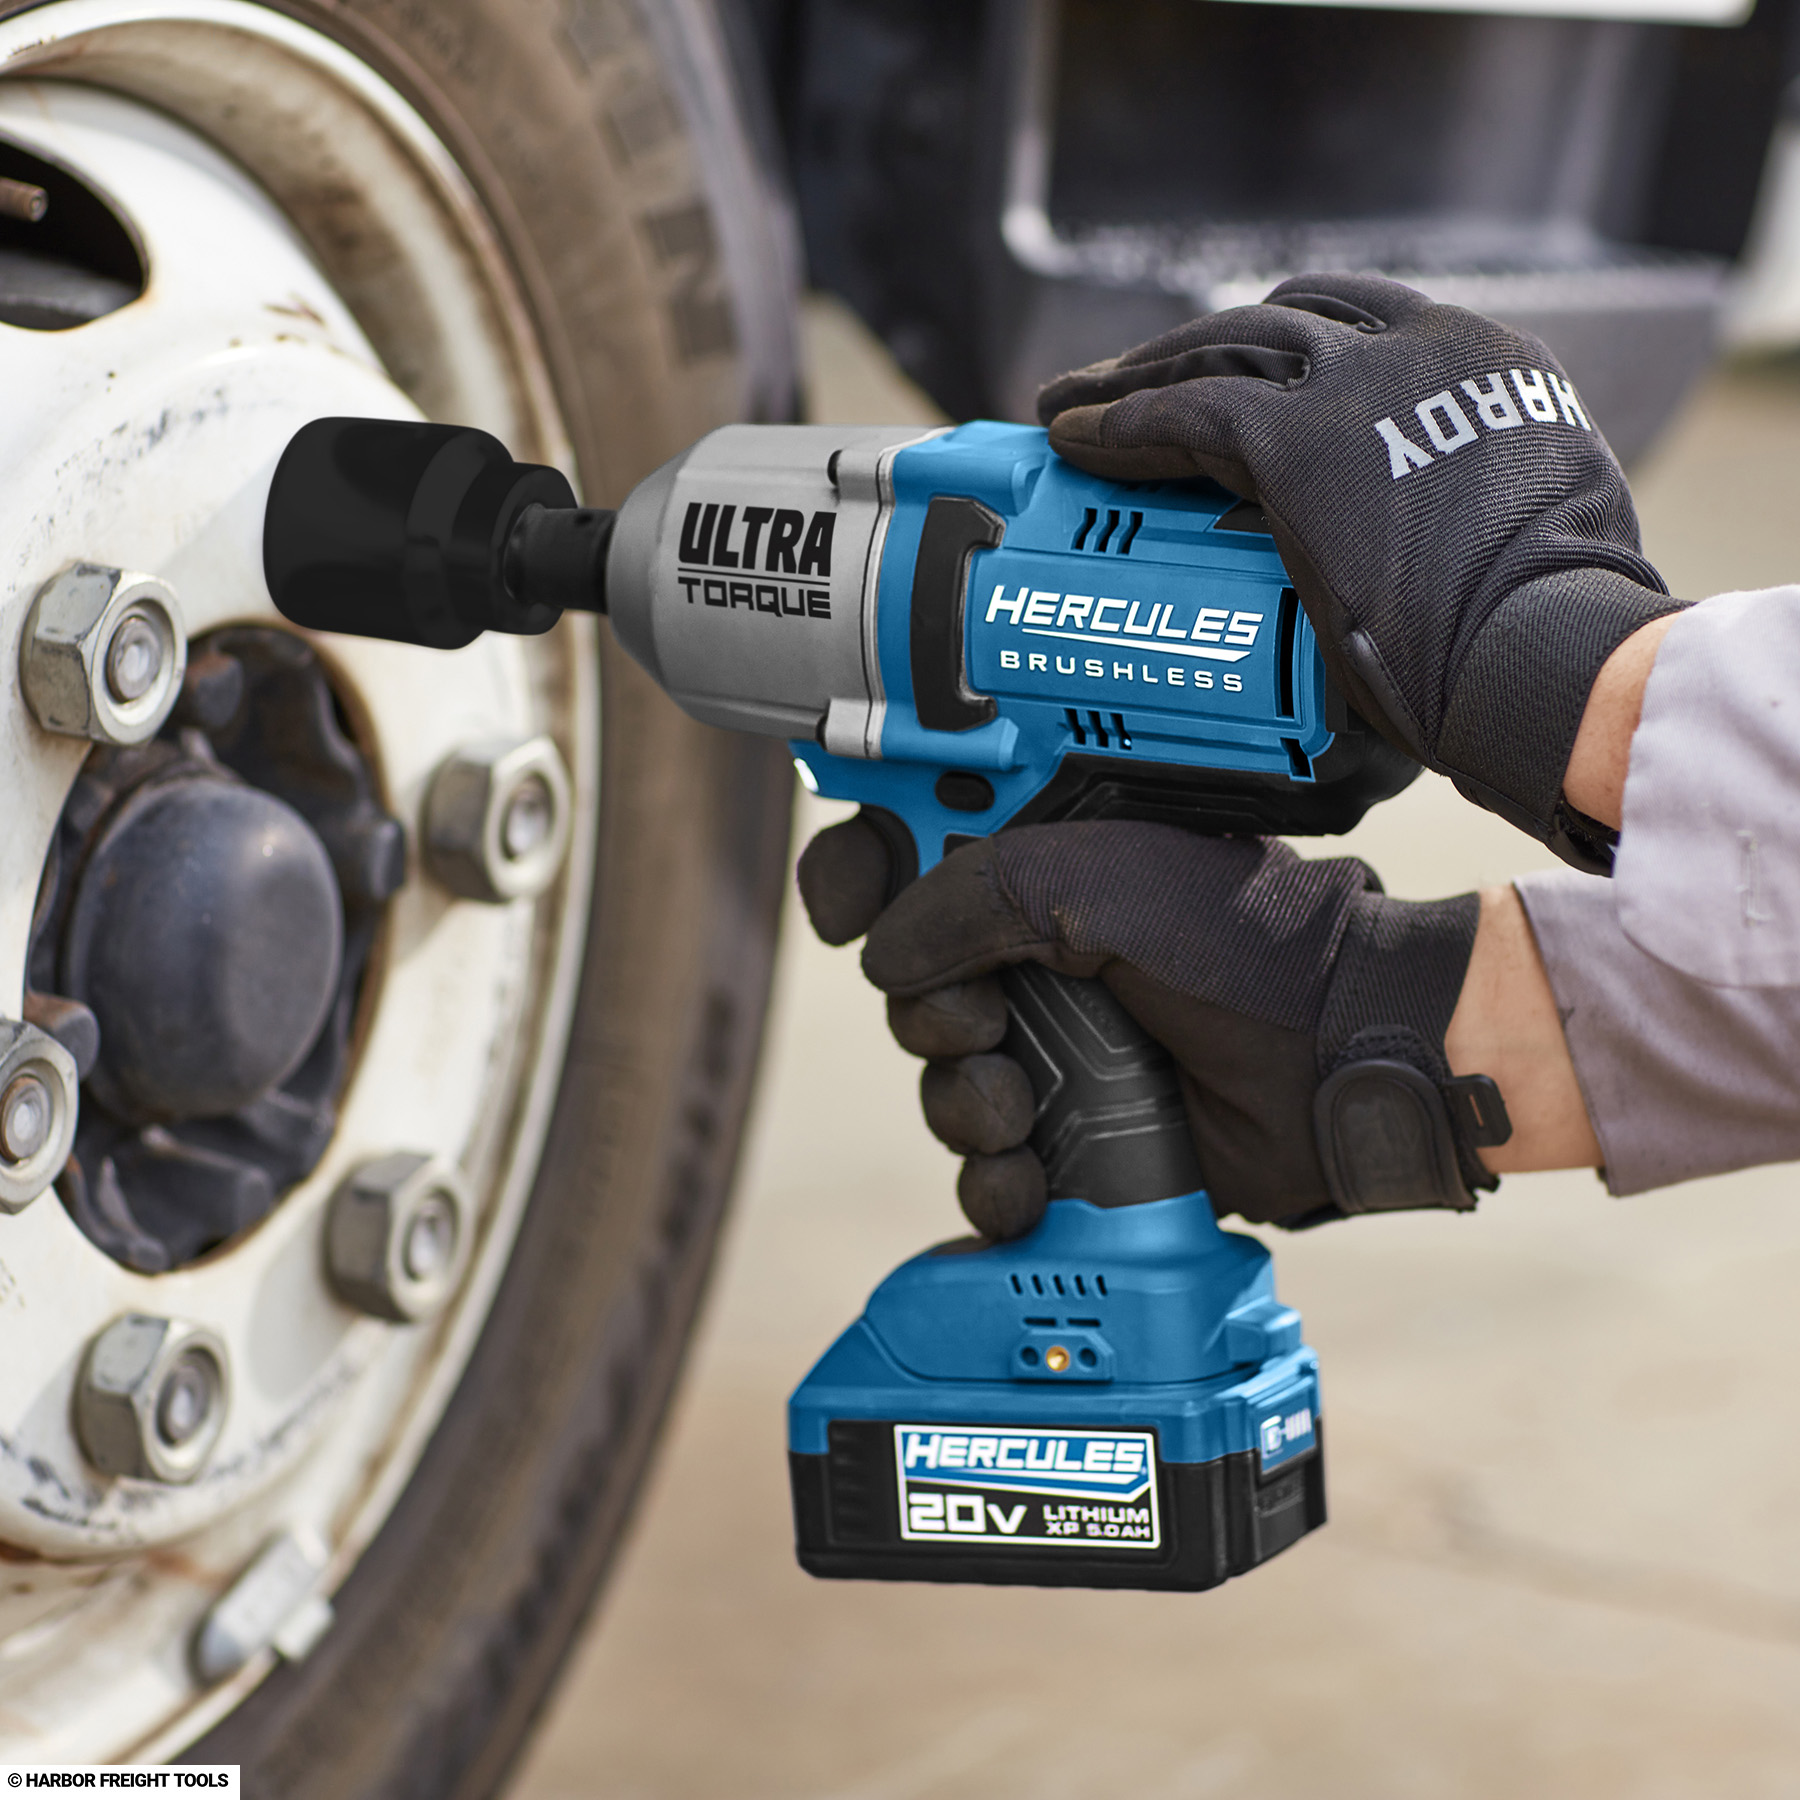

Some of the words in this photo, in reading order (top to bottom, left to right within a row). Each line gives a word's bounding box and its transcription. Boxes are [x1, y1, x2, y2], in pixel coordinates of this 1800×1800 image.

[1374, 368, 1591, 480] HARDY
[678, 502, 837, 577] ULTRA
[678, 576, 832, 620] TORQUE
[985, 585, 1264, 646] HERCULES
[1000, 650, 1243, 692] BRUSHLESS
[905, 1433, 1145, 1473] HERCULES
[1043, 1505, 1150, 1524] LITHIUM
[1046, 1521, 1080, 1536] XP
